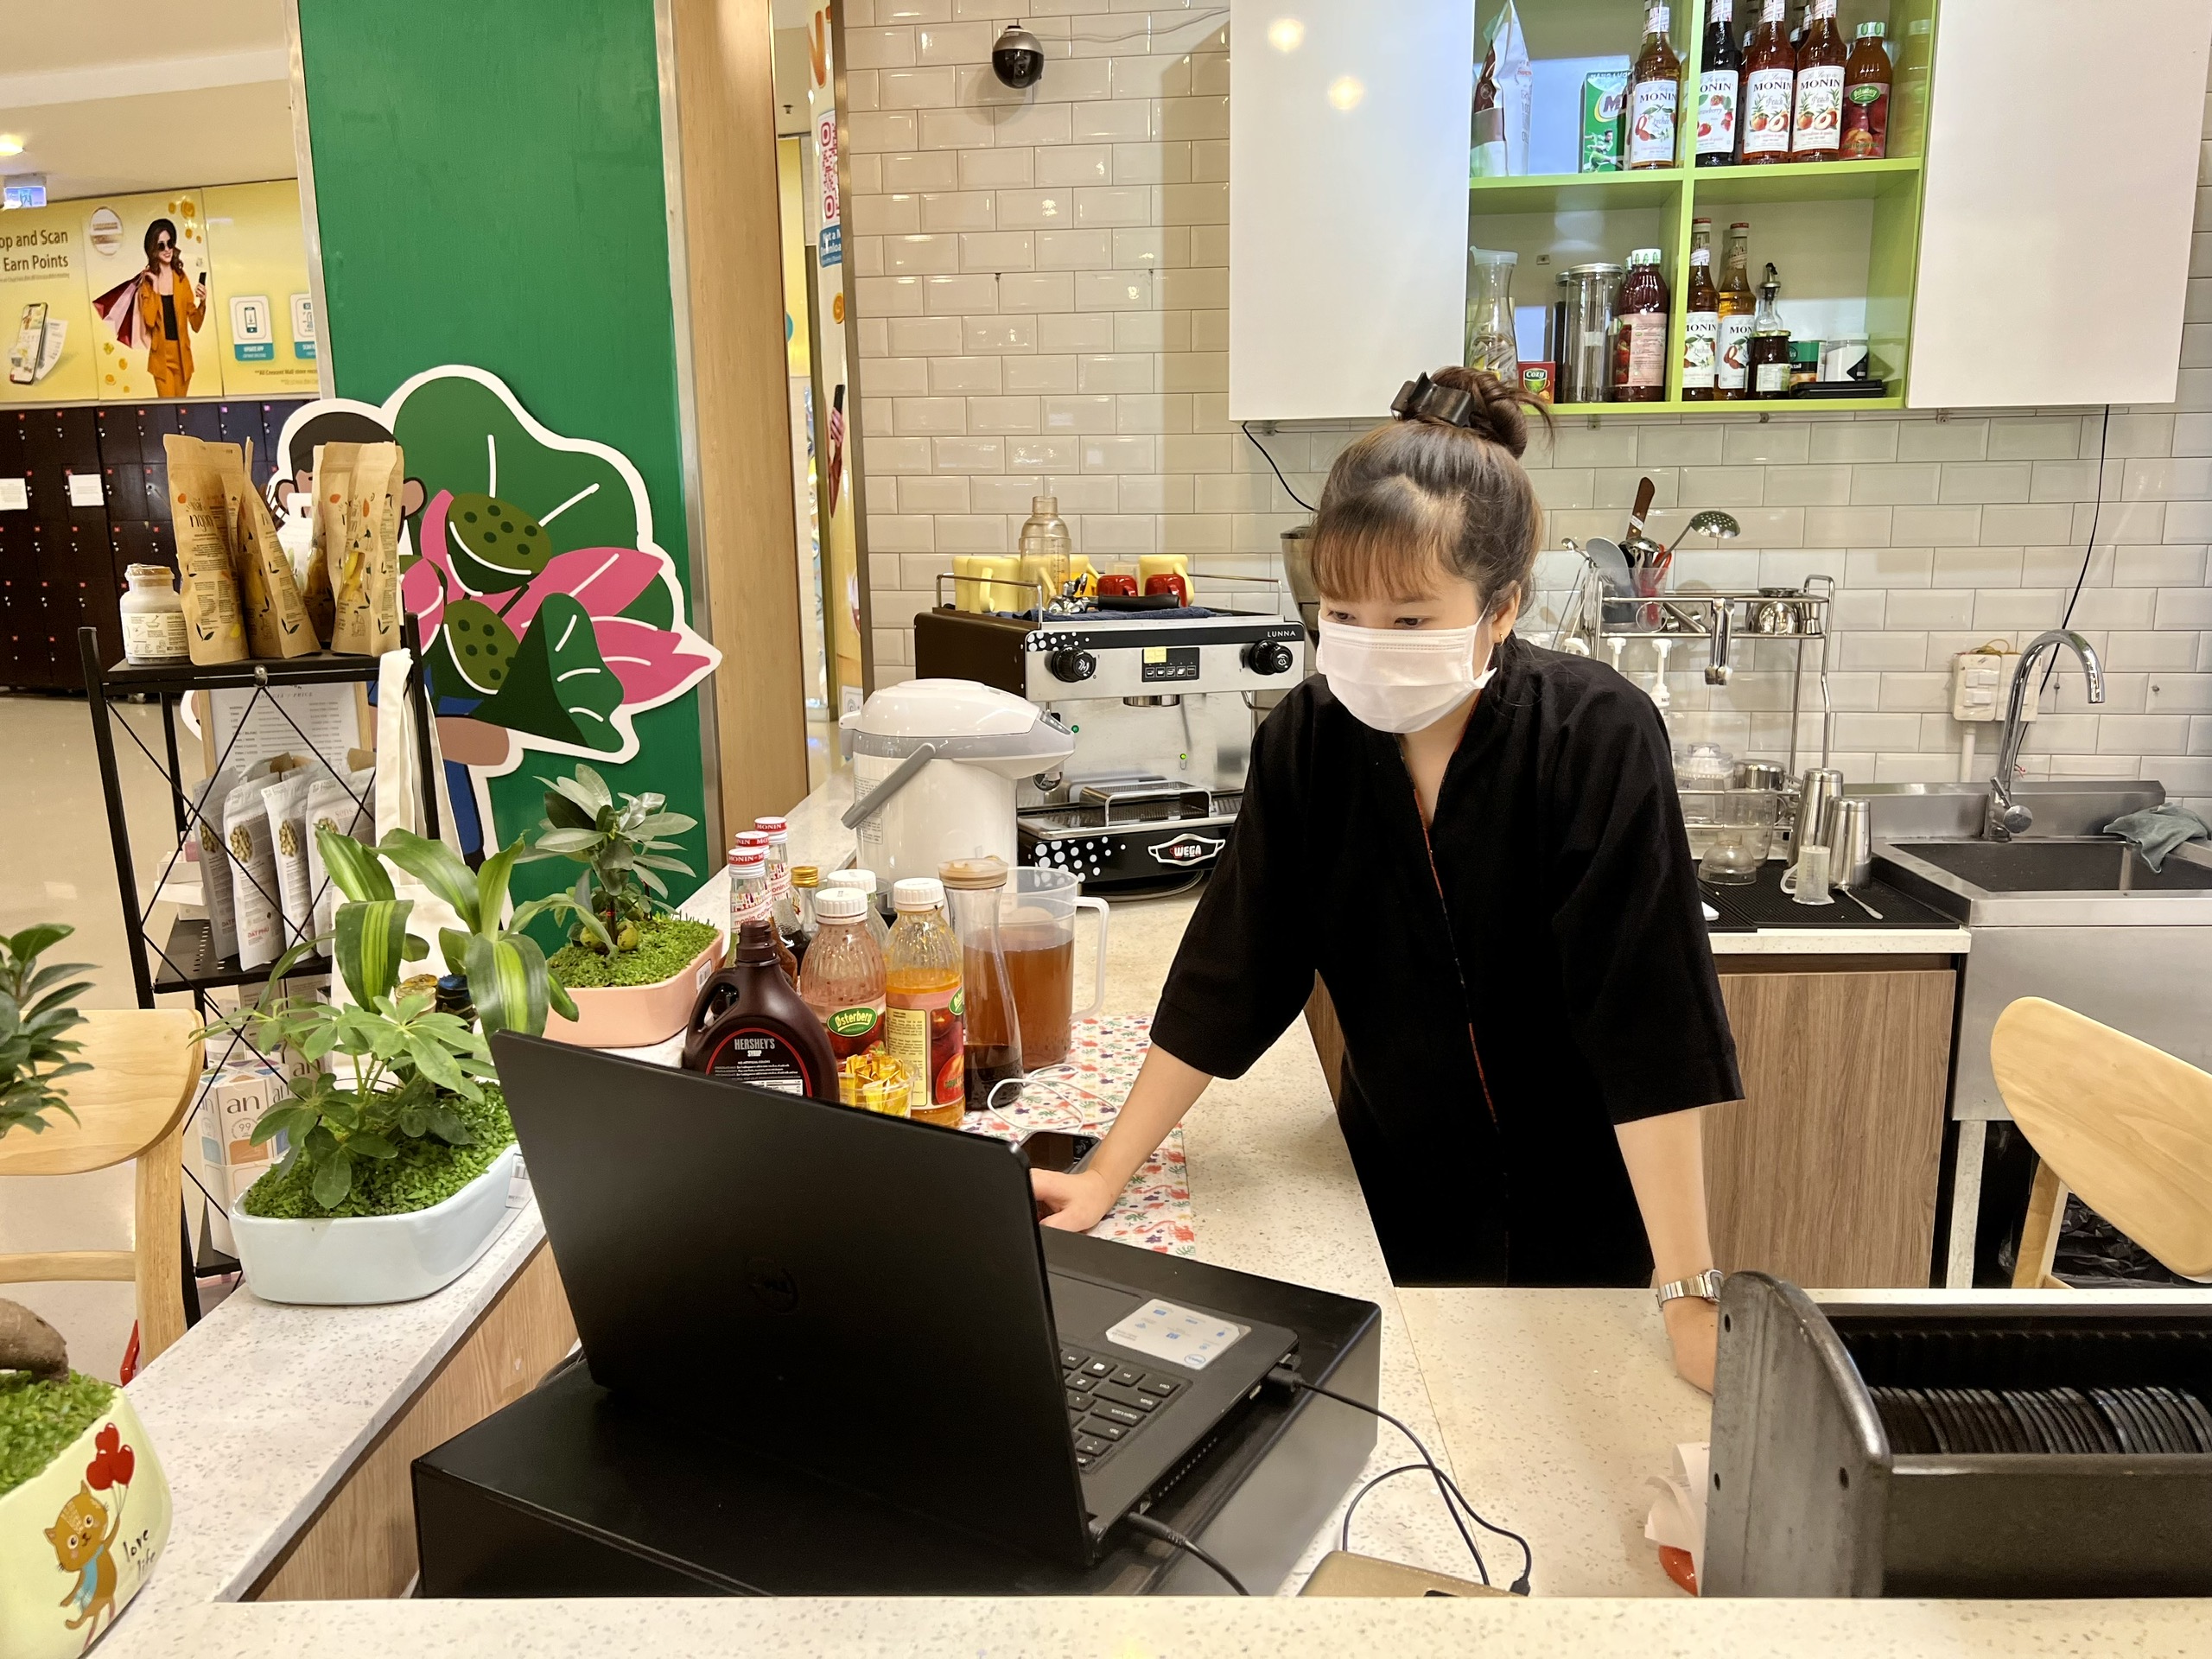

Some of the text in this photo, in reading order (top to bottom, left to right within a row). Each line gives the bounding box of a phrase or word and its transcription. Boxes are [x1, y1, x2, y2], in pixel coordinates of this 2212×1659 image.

[1700, 82, 1732, 93] ONIN
[1753, 81, 1792, 92] MONIN
[1800, 79, 1840, 91] MONIN
[1640, 92, 1677, 103] MONIN
[16, 230, 38, 249] and
[41, 229, 69, 246] Scan
[3, 253, 69, 272] Earn Points
[1730, 326, 1752, 334] MON
[1525, 369, 1545, 378] Cozy
[1174, 844, 1202, 858] WEGA
[835, 1011, 873, 1028] Østerberg
[734, 1038, 776, 1051] HERSHEY'S
[226, 1095, 261, 1115] an
[238, 1122, 251, 1132] 99
[123, 1529, 149, 1563] love
